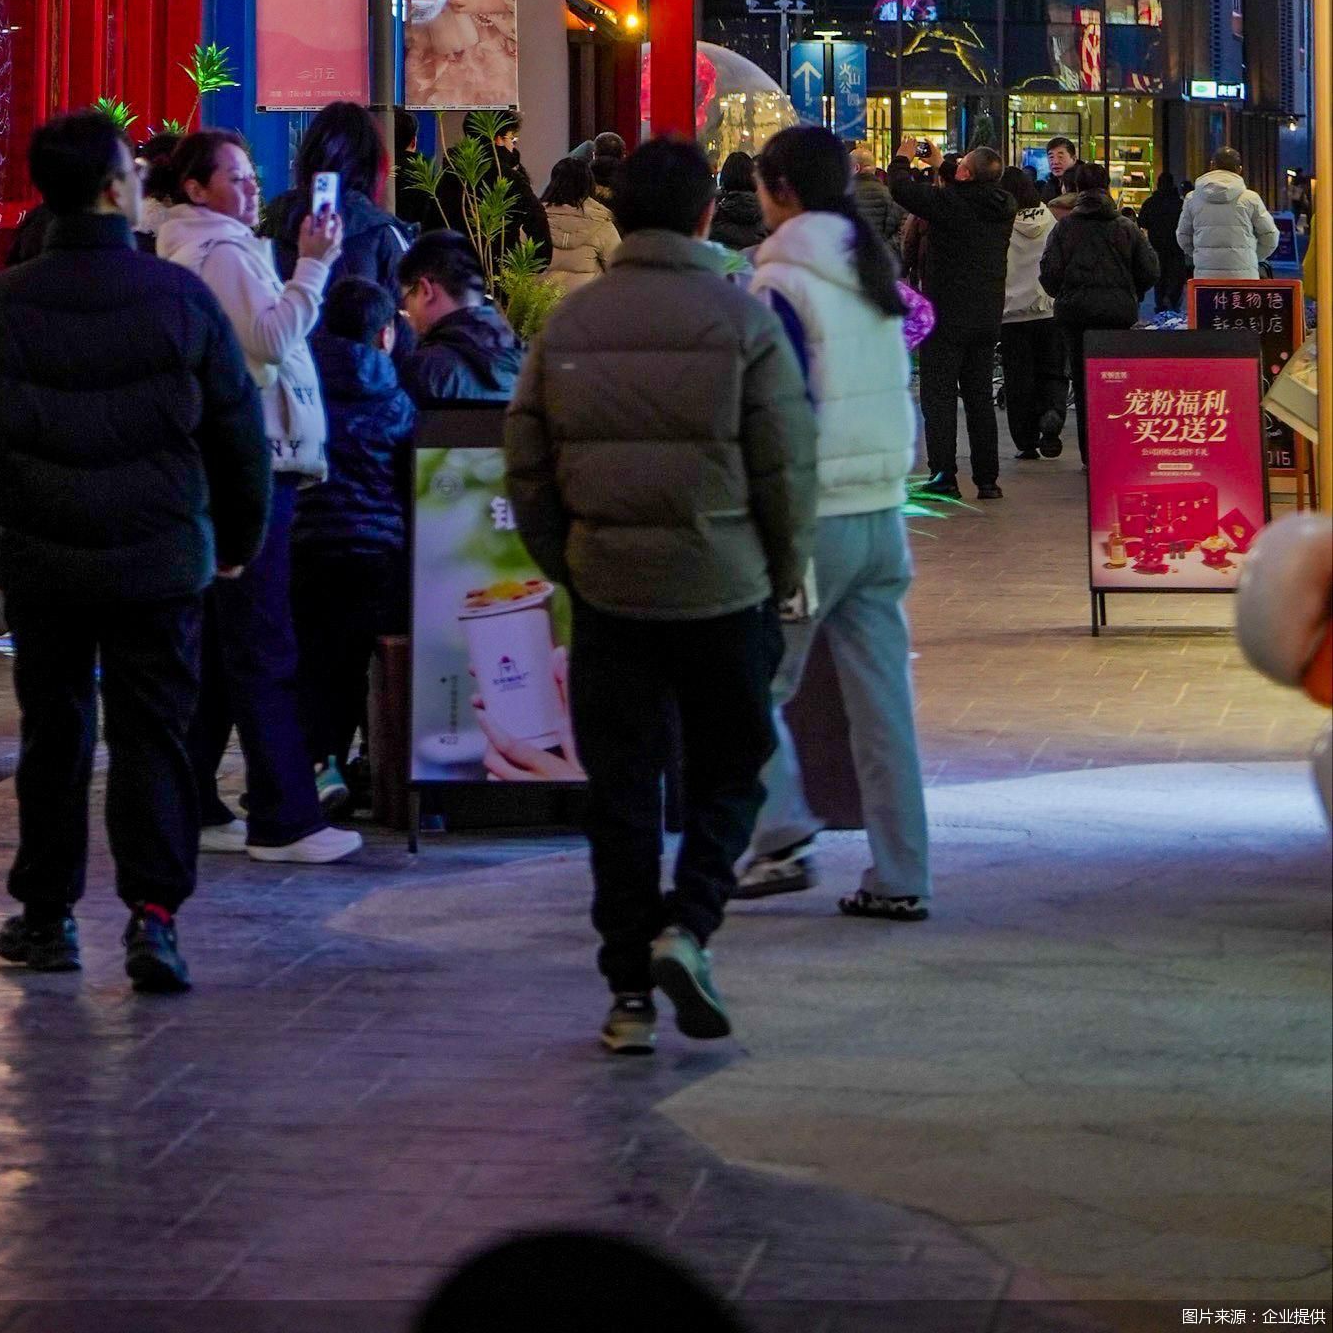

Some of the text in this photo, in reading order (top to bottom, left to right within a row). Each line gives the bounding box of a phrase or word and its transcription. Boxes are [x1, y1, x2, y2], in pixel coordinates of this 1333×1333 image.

[1213, 292, 1284, 311] 仲夏物语
[1107, 388, 1227, 420] 宠粉福利
[1130, 417, 1227, 445] 买2送2
